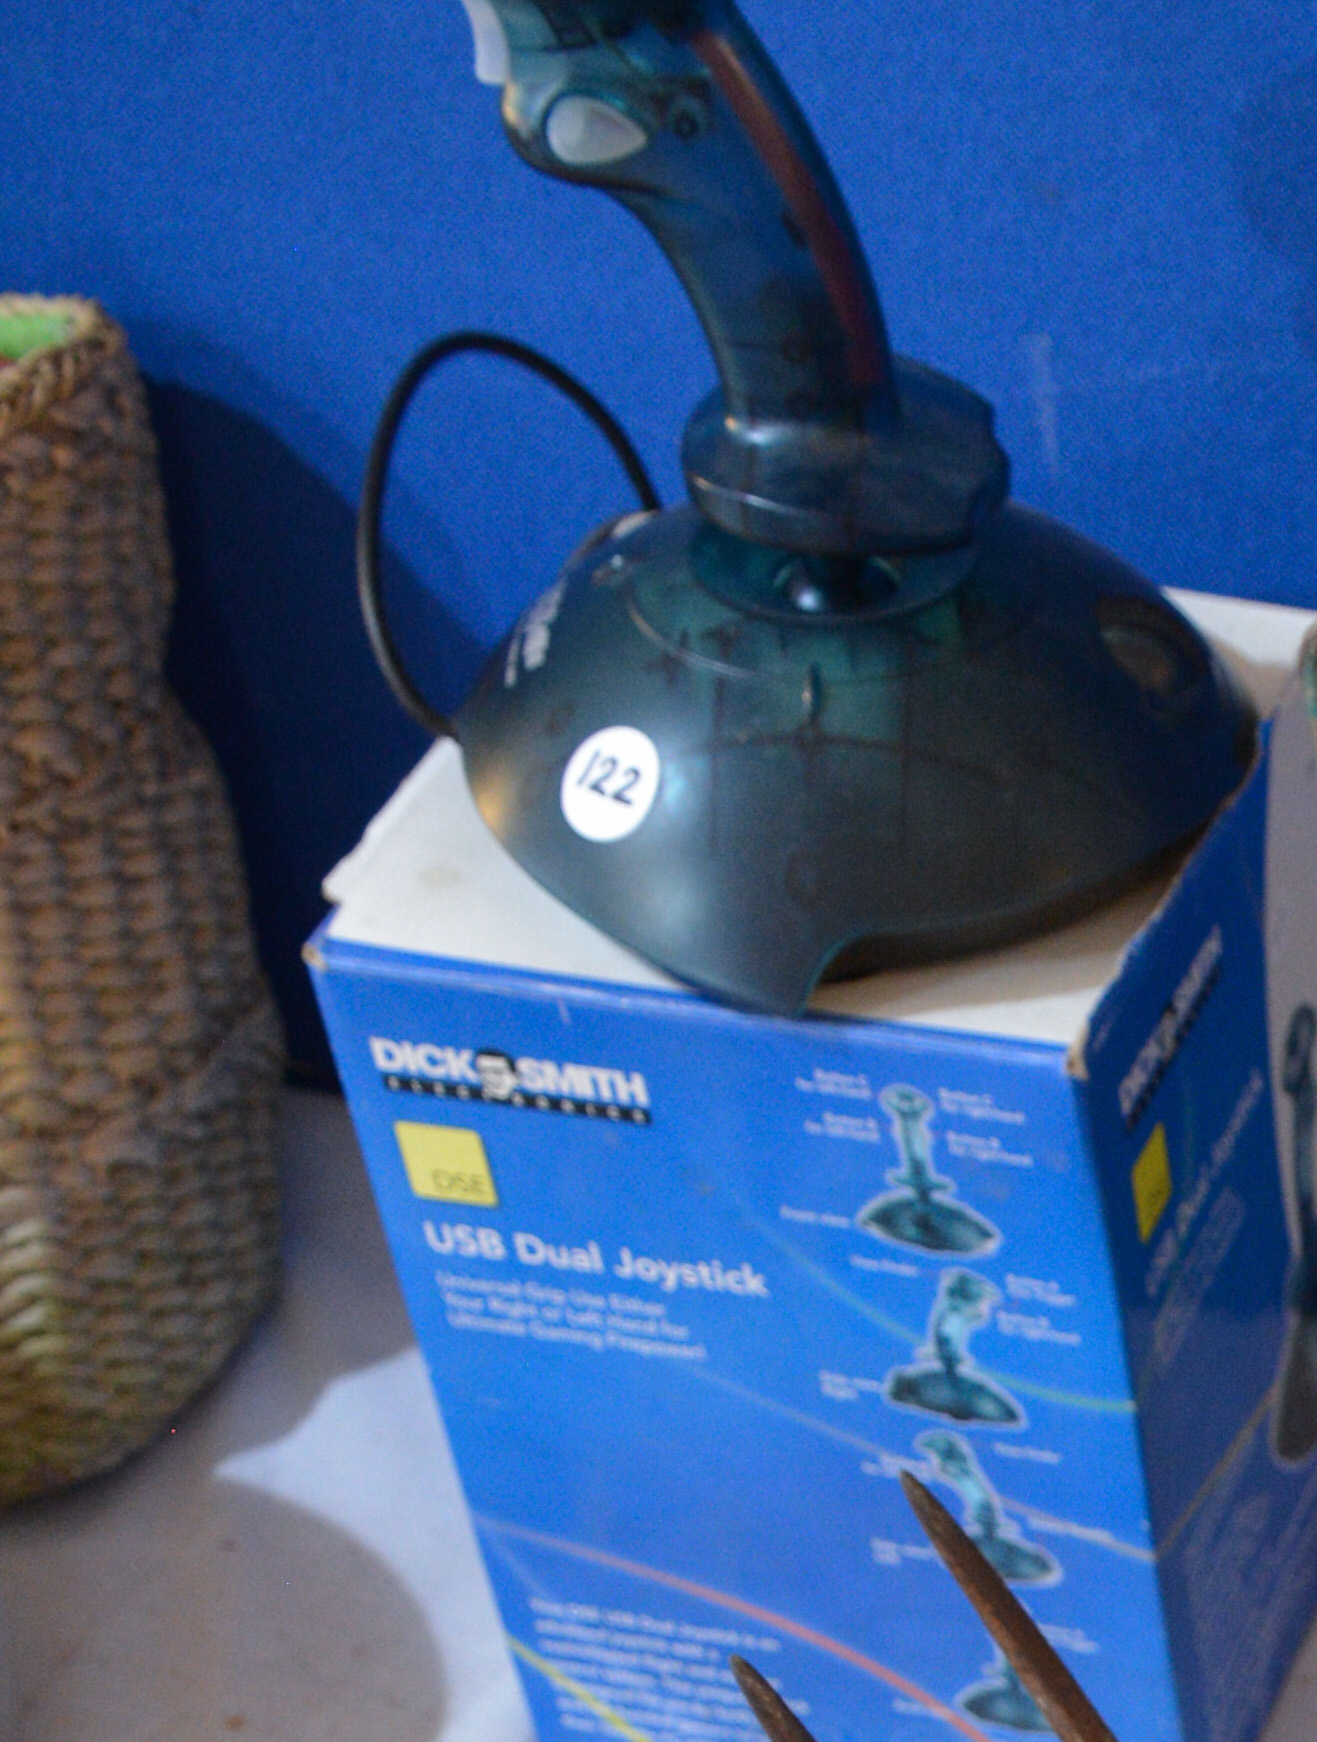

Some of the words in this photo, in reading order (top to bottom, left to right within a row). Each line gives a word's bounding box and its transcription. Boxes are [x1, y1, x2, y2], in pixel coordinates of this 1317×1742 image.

[577, 749, 640, 805] 122
[369, 1035, 479, 1084] DICK
[516, 1056, 651, 1107] SMITH
[431, 1167, 489, 1195] DSE
[423, 1220, 506, 1261] USB
[513, 1231, 606, 1275] Dual
[614, 1246, 771, 1298] Joystick
